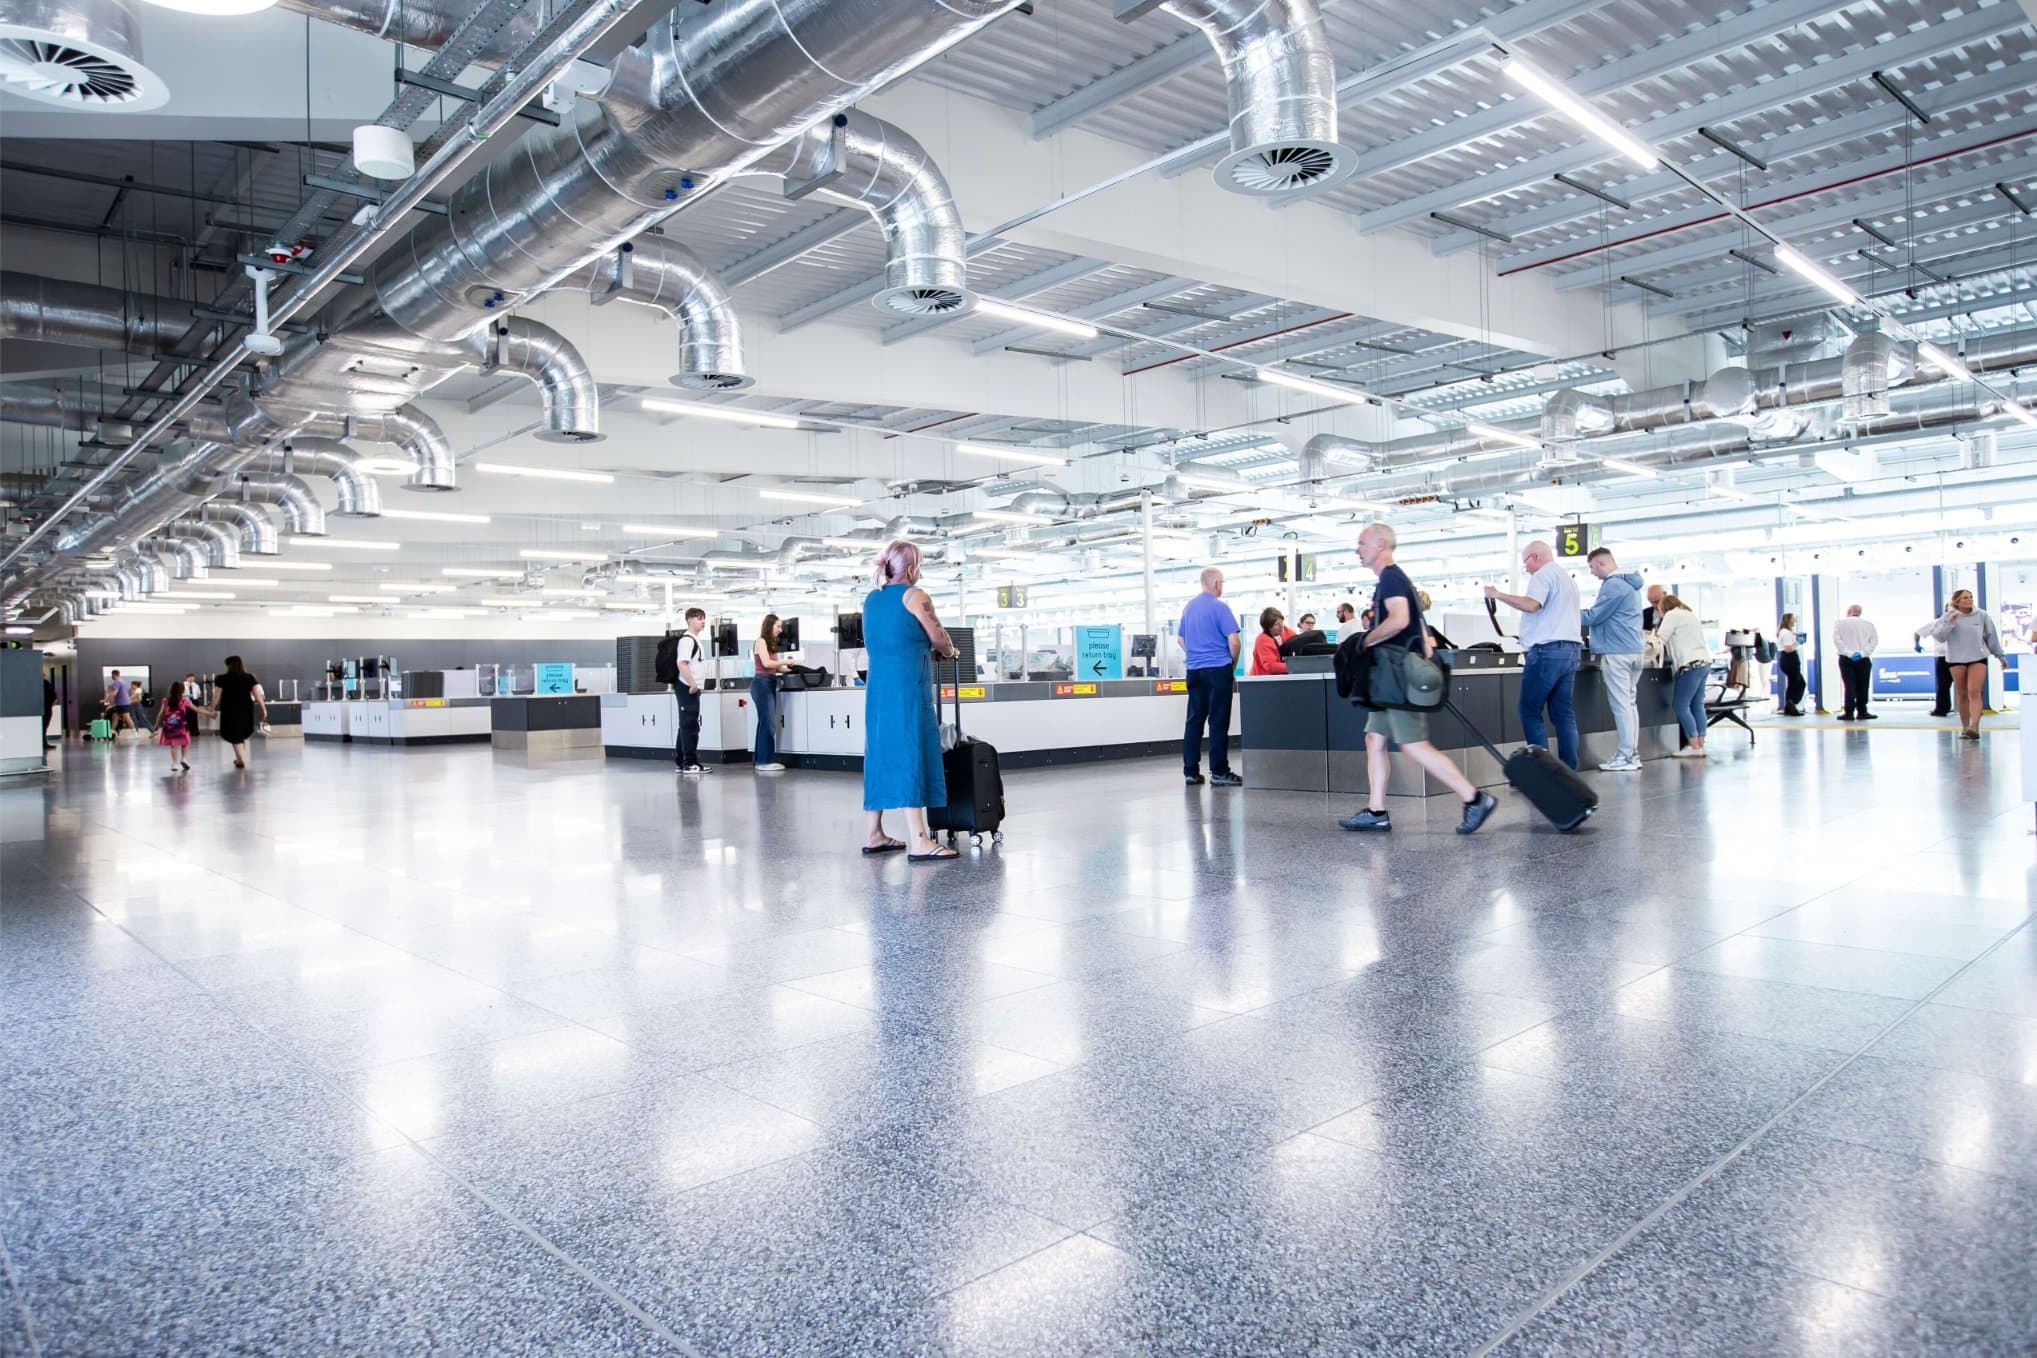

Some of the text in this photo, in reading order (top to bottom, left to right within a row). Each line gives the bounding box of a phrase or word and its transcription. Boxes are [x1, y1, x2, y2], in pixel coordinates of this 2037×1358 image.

[1564, 533, 1579, 555] 5
[1016, 592, 1025, 607] 3
[1088, 642, 1109, 650] please
[1082, 651, 1117, 660] return tray
